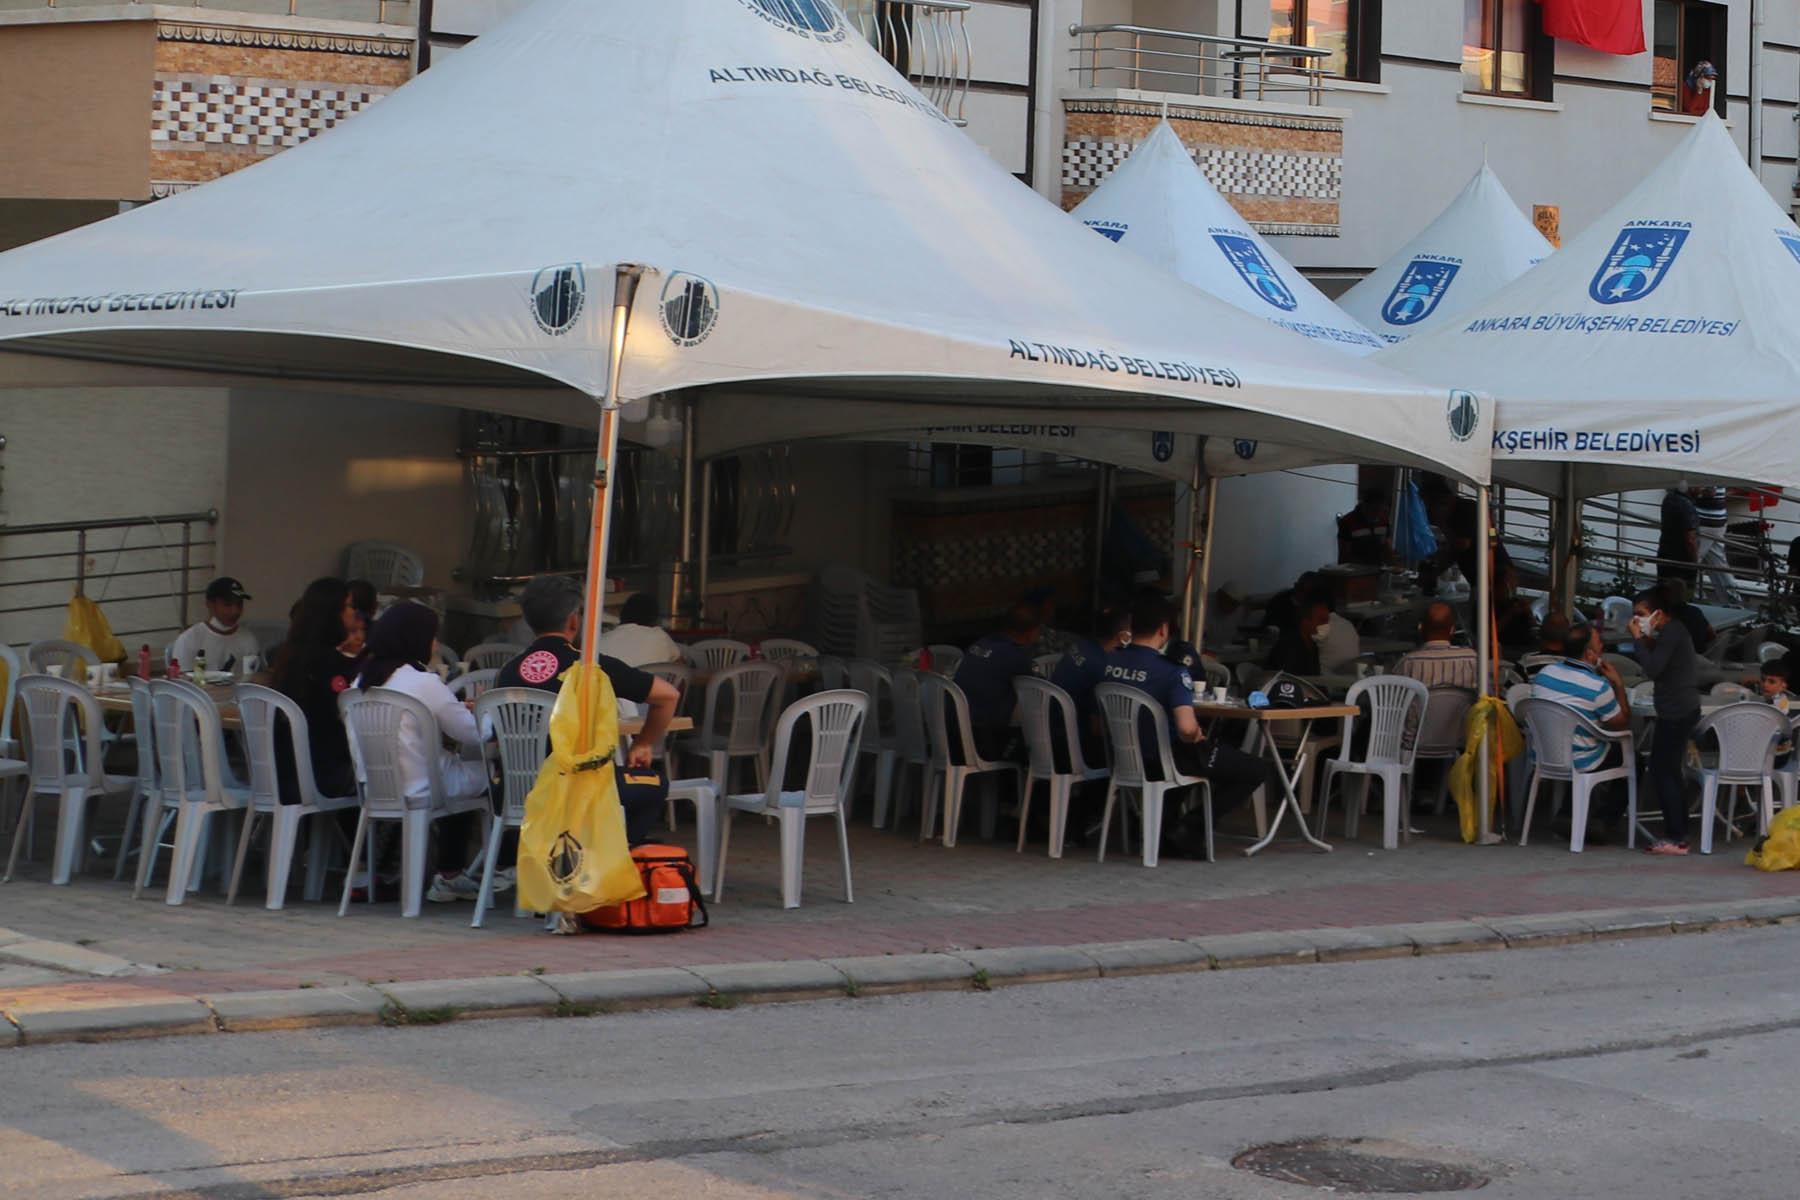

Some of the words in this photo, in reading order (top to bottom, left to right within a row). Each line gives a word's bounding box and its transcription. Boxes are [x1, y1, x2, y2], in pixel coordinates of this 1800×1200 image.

[709, 66, 833, 87] ALTINDAĞ
[1623, 220, 1693, 229] ANKARA
[1413, 253, 1464, 264] ANKARA
[1464, 314, 1531, 333] ANKARA
[1532, 312, 1640, 335] BÜYÜKŞEHİR
[1638, 316, 1742, 337] BELEDİYESİ
[1008, 339, 1119, 373] ALTINDAĞ
[1119, 355, 1242, 389] BELEDİYESİ
[1573, 428, 1701, 454] BELEDİYESİ
